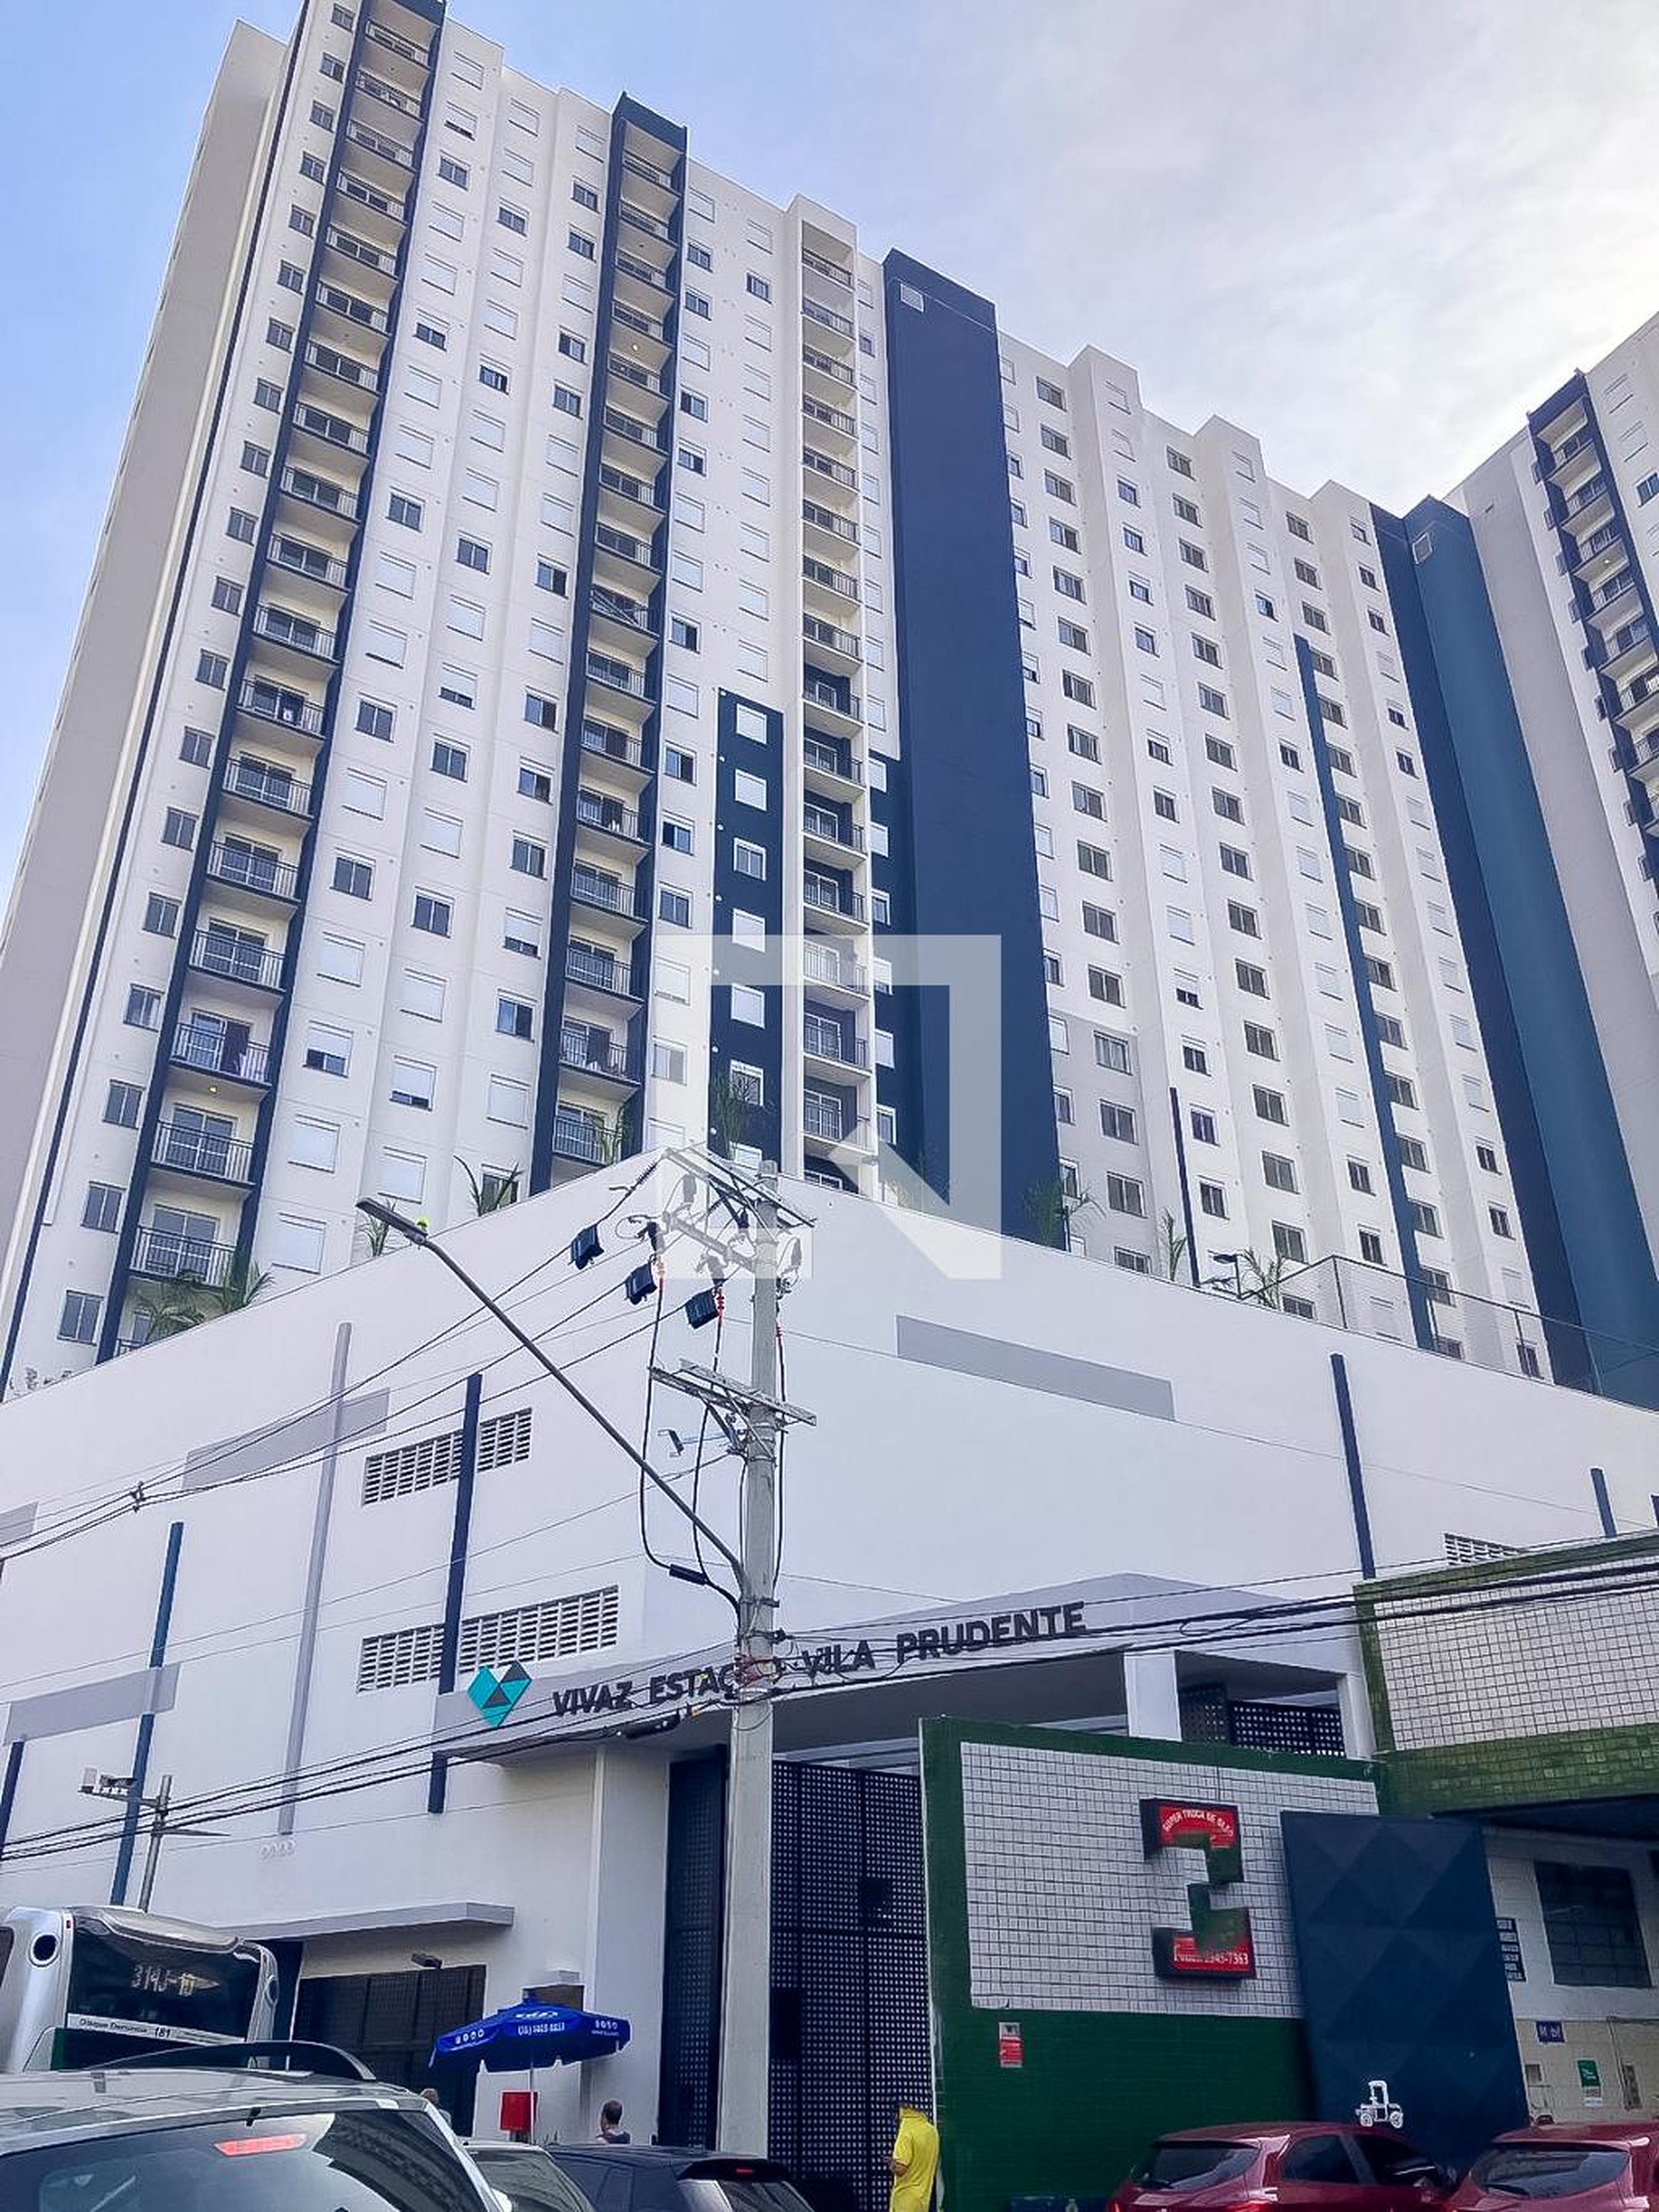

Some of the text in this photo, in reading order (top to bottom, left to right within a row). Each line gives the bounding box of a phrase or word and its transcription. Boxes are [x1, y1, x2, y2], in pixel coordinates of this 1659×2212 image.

[553, 1680, 635, 1717] VIVAZ
[802, 1640, 875, 1677] VILA
[896, 1601, 1087, 1664] PRUDENTE
